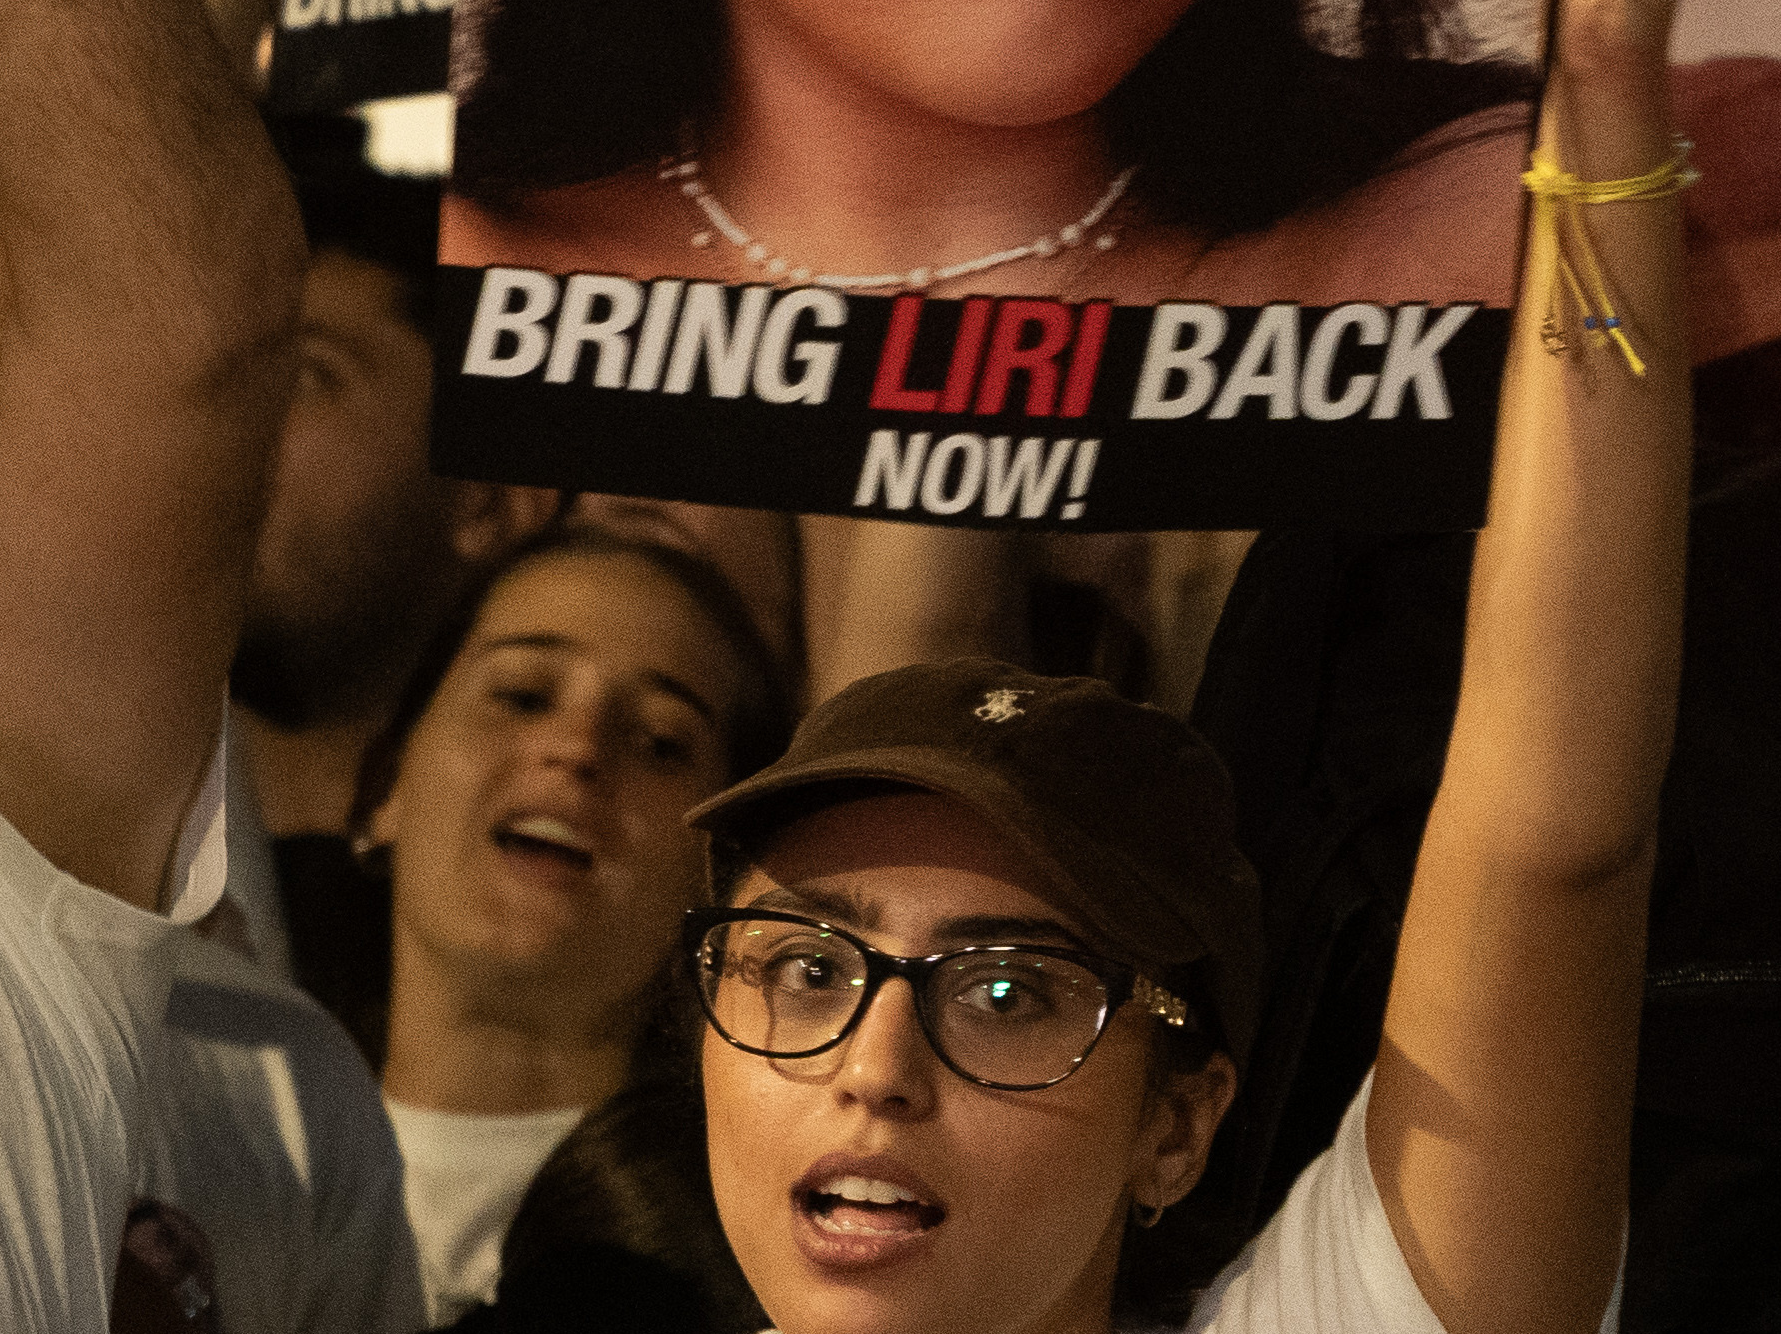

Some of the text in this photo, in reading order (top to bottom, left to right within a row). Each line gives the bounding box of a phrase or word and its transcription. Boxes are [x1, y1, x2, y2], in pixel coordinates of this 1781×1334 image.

[459, 266, 1482, 420] BRING LIRI BACK
[853, 428, 1102, 519] NOW!
